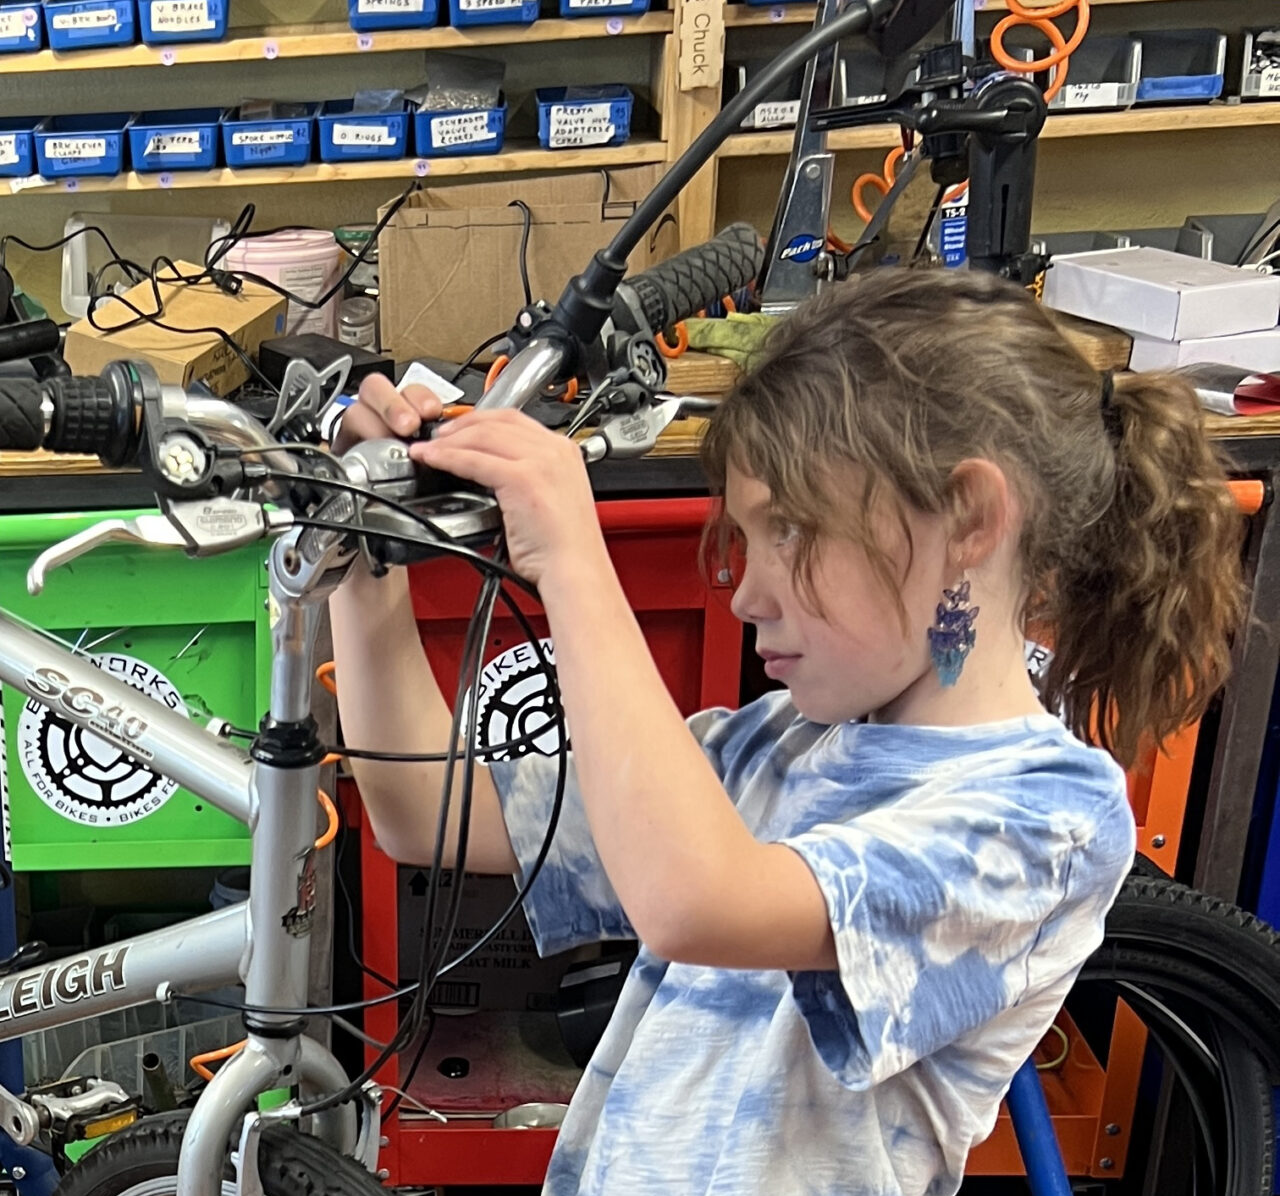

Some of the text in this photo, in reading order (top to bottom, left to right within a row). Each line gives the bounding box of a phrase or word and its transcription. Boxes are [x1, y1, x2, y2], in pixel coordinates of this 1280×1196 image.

[692, 13, 711, 76] Chuck
[945, 206, 966, 218] TS-2
[24, 739, 35, 768] ALL
[32, 772, 54, 799] FOR
[55, 800, 98, 823] BIKES
[120, 778, 178, 823] BIKES FO
[493, 958, 532, 969] MILK
